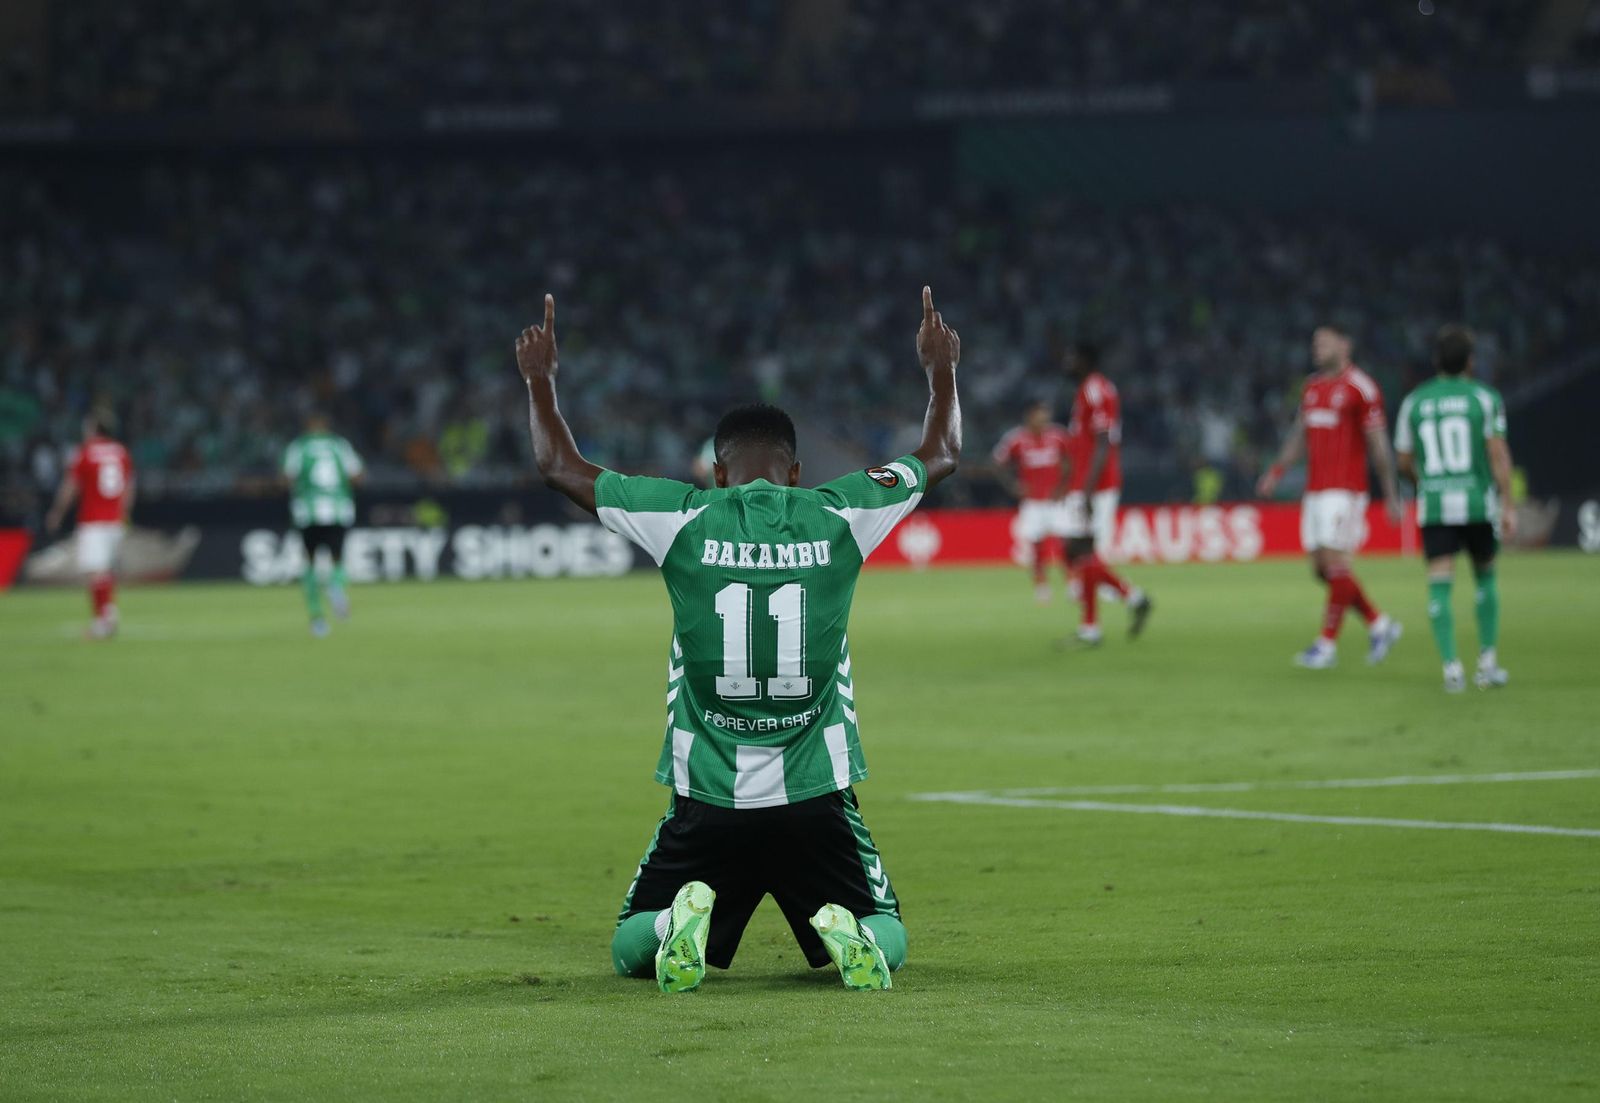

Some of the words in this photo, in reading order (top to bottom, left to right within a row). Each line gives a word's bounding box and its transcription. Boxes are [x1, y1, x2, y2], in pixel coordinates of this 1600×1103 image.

[1418, 416, 1471, 476] 10
[241, 528, 447, 586] SAETY
[453, 524, 634, 580] SHOES
[701, 539, 831, 569] BAKAMBU
[715, 582, 812, 701] 11
[704, 709, 778, 731] FOREVER
